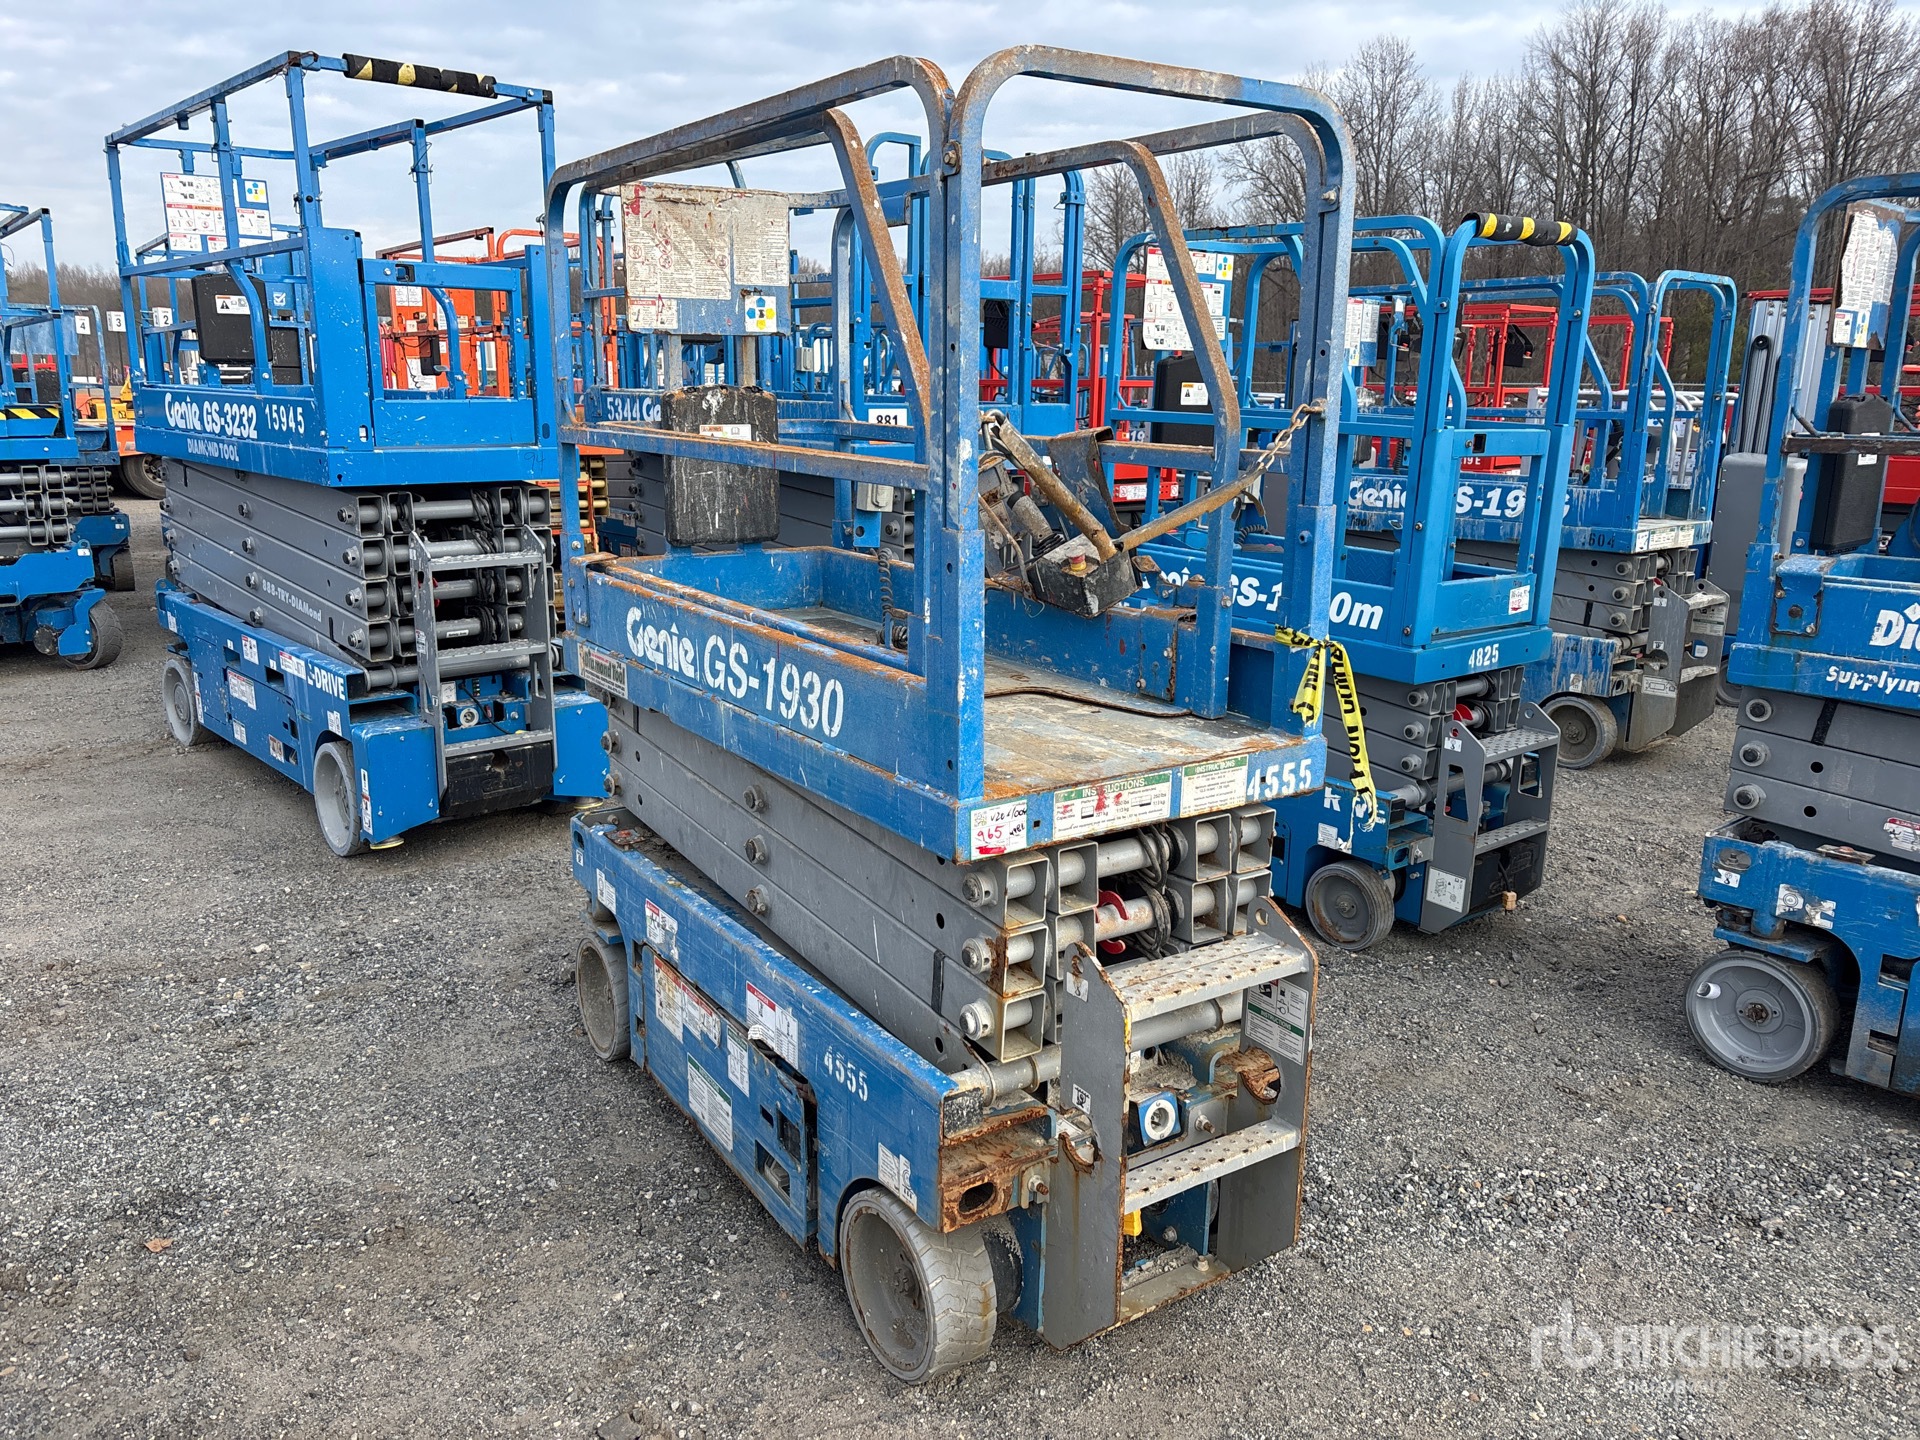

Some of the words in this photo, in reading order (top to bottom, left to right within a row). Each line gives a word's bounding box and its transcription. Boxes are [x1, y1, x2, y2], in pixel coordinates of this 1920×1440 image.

[80, 322, 86, 330] 4
[116, 318, 122, 328] 3
[165, 392, 201, 431] Genie
[203, 400, 258, 439] GS-3232
[265, 403, 305, 435] 15945
[606, 397, 640, 421] 5344
[186, 437, 219, 458] DIAMOND
[219, 442, 240, 462] TOOL
[1468, 643, 1499, 668] 4825
[626, 606, 697, 679] Genie
[704, 634, 844, 738] GS-1930
[1826, 665, 1920, 699] Supplyin
[1246, 758, 1311, 801] 4555
[824, 1046, 868, 1102] 4555
